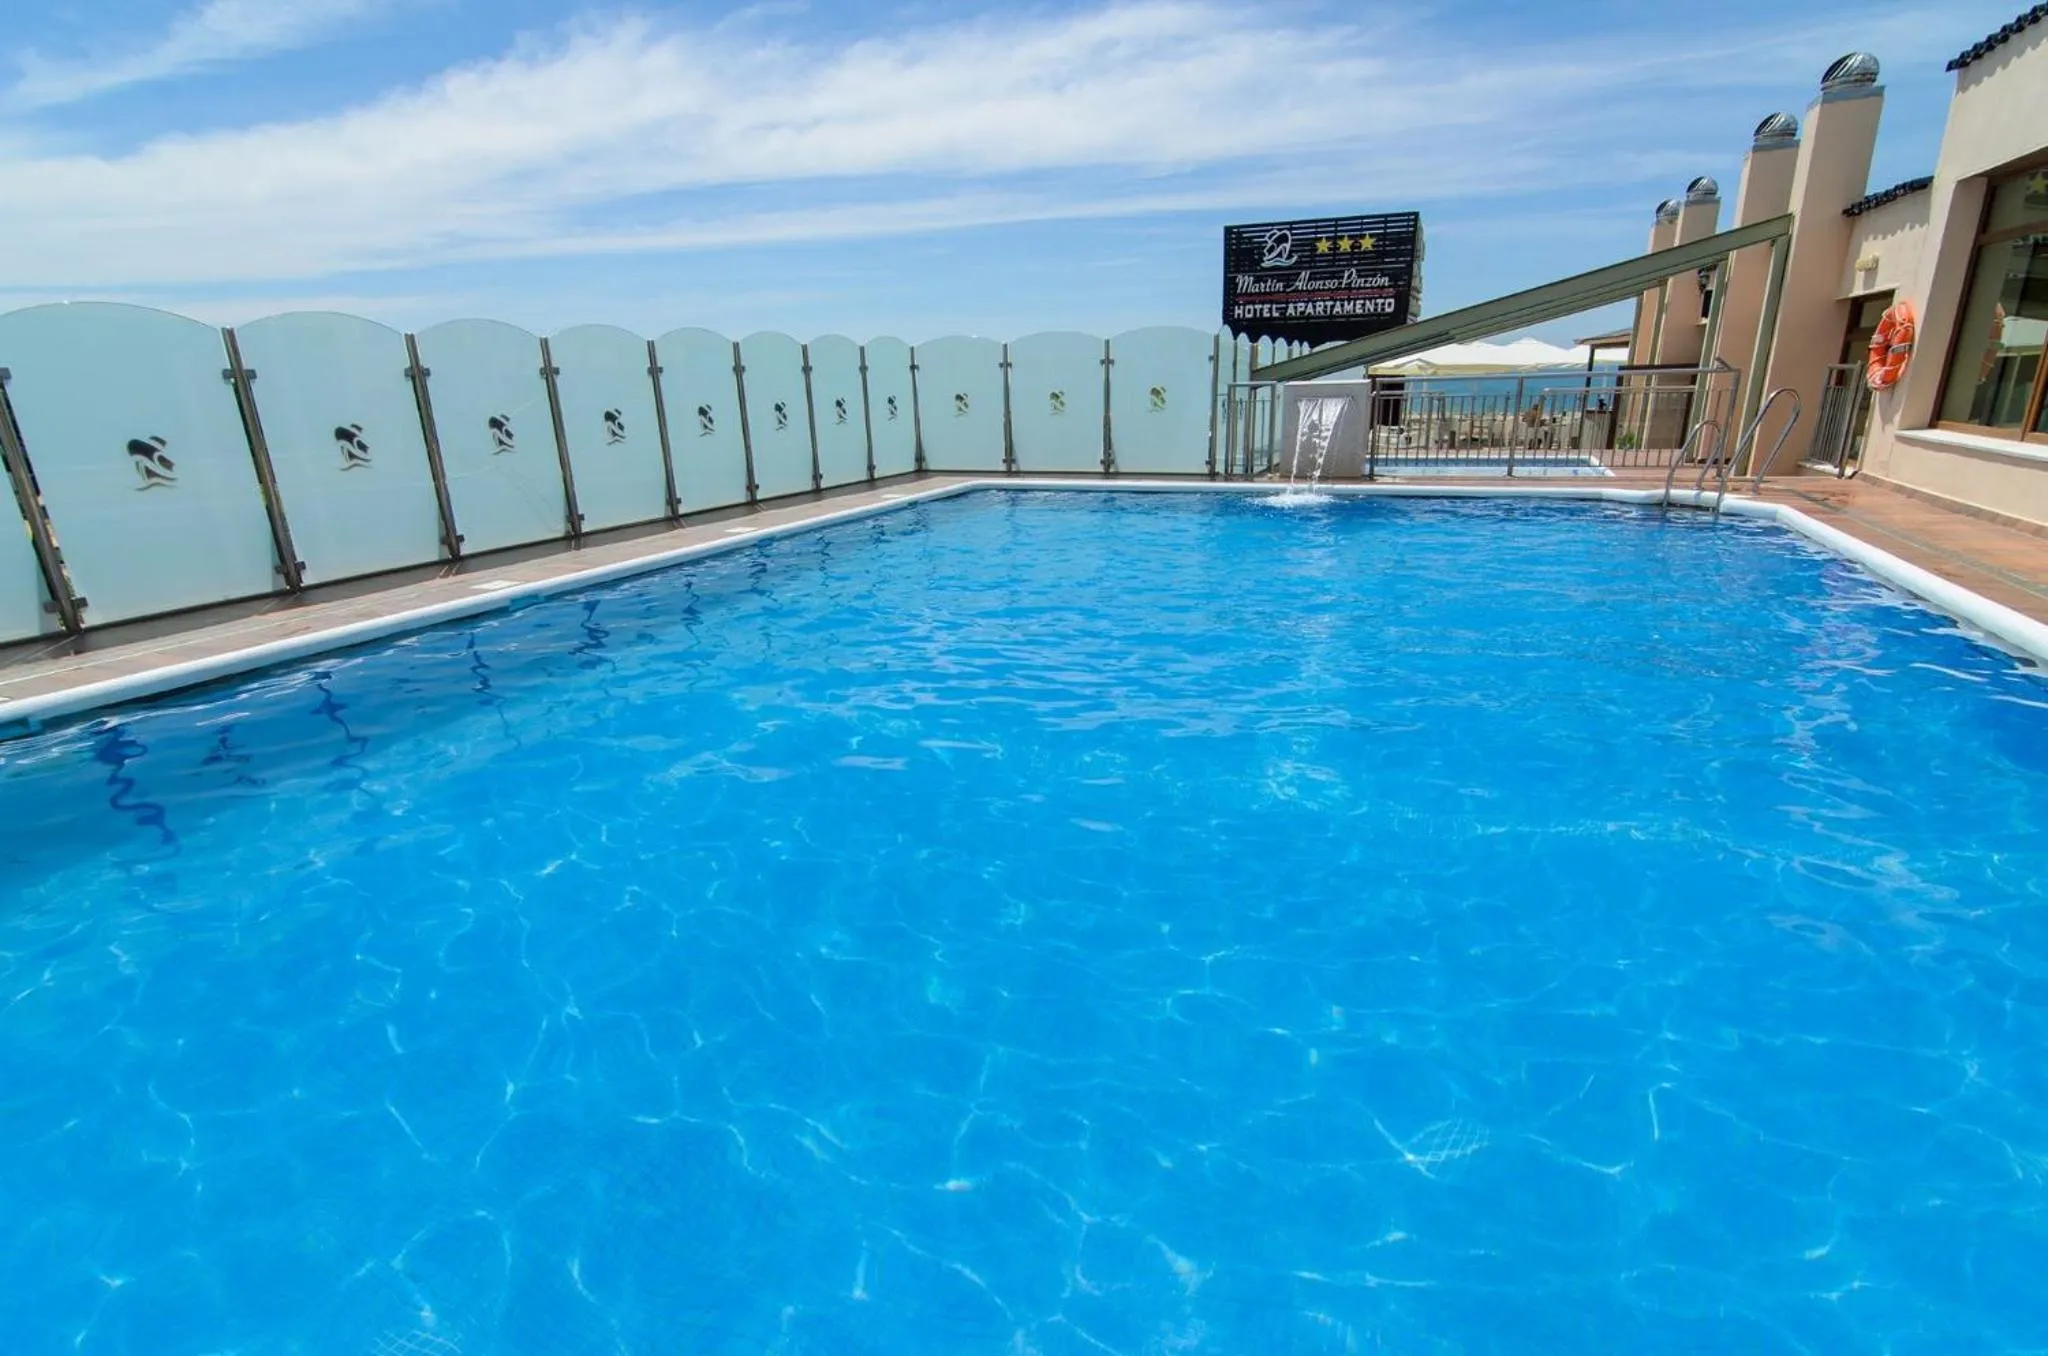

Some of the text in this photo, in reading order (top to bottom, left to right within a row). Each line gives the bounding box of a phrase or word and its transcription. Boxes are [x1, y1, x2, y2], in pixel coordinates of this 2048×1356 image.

[1286, 270, 1338, 291] Alonso
[1341, 268, 1389, 288] Pinzón
[1234, 298, 1395, 319] HOTEL APARTAMENTO
